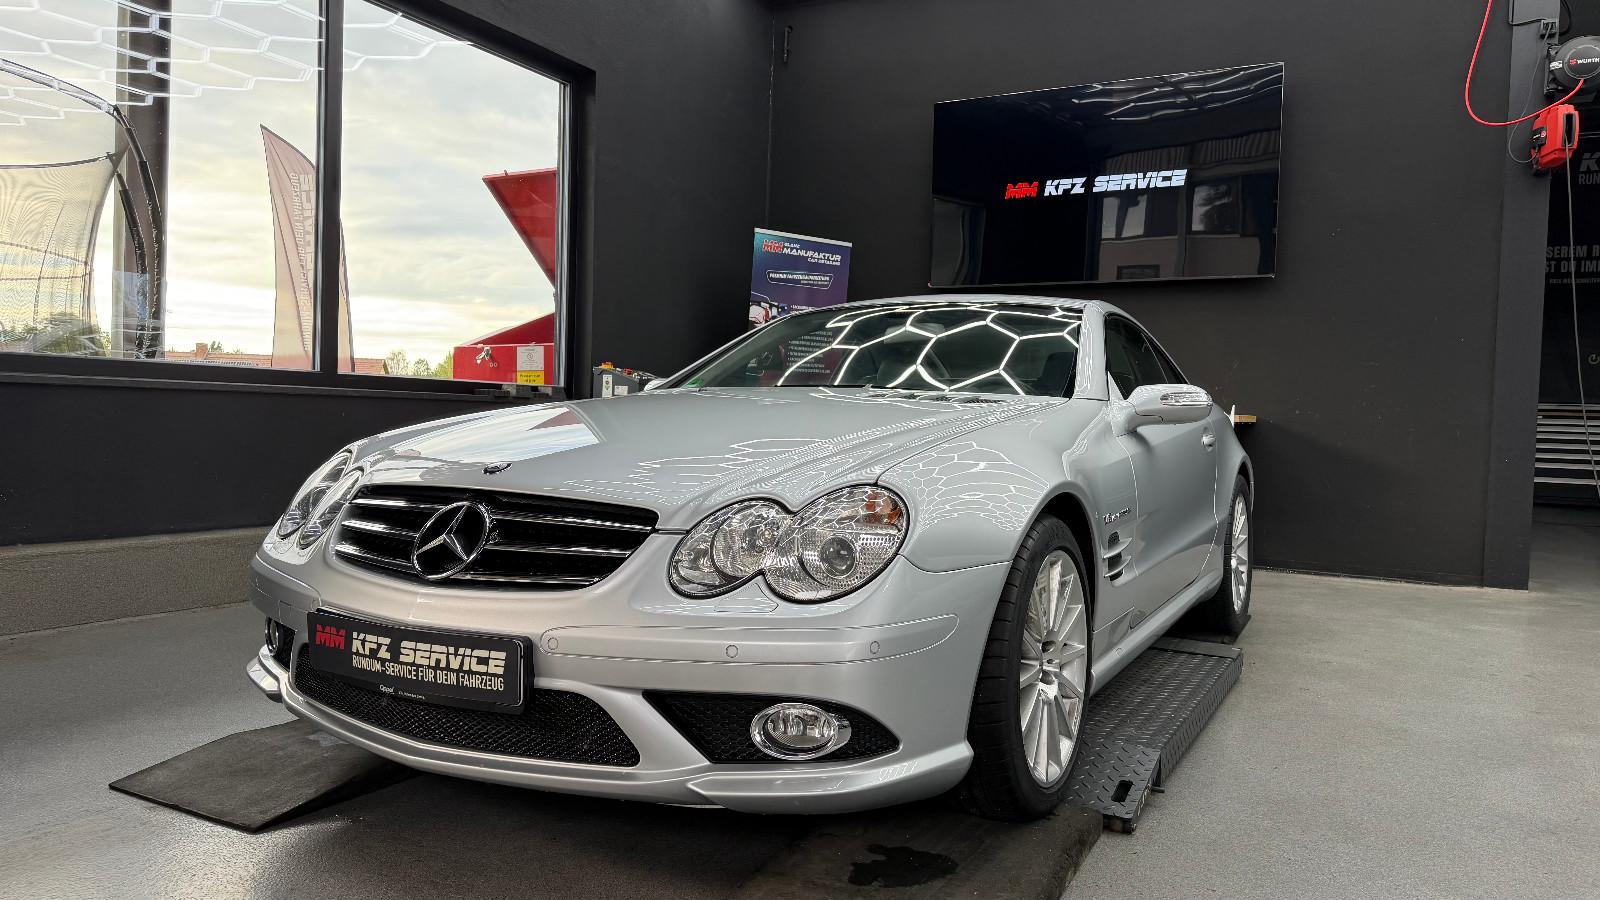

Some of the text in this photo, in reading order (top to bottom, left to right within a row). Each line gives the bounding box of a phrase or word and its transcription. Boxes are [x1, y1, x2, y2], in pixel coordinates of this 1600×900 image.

[1005, 169, 1188, 199] MM KFZ SERVICE
[783, 248, 841, 262] MANUFAKTUR
[315, 623, 507, 675] MM KFZ SERVICE
[352, 654, 504, 691] RUNDUM-SERVICE FÜR DEIN FAHRZEUG
